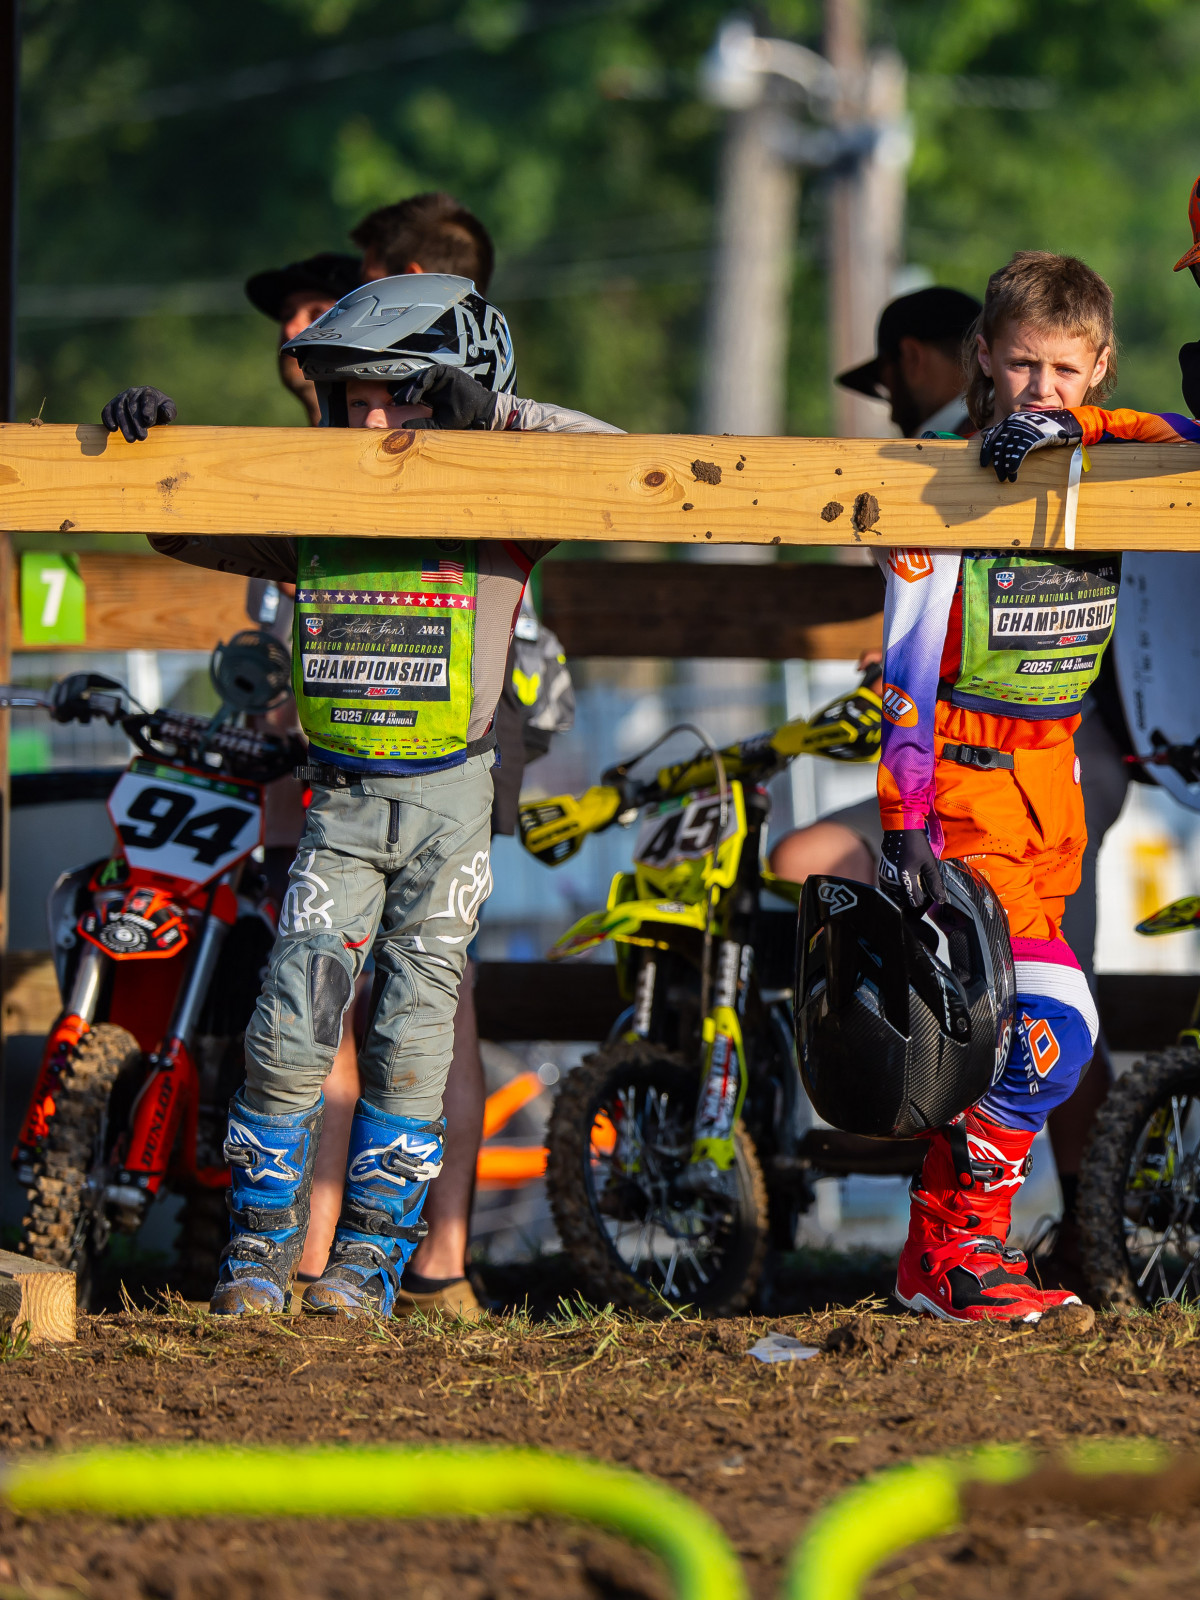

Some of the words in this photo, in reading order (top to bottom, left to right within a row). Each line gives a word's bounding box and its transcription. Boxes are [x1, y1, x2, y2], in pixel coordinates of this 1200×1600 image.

[41, 568, 67, 626] 7
[995, 594, 1036, 604] AMATEUR
[1039, 591, 1074, 603] NATIONAL
[1077, 585, 1116, 599] MOTOCROSS
[996, 603, 1115, 632] CHAMPIONSHIP
[416, 625, 445, 636] AMA
[305, 641, 341, 651] AMATEUR
[344, 642, 386, 652] NATIONAL
[390, 643, 444, 654] MOTOCROSS
[1056, 634, 1089, 646] AMSOIL
[306, 658, 443, 682] CHAMPIONSHIP
[1020, 661, 1053, 673] 2025
[1060, 658, 1073, 671] 44
[1072, 661, 1094, 671] ANNUAL
[364, 687, 401, 696] AMSOIL
[883, 687, 914, 717] 110
[334, 710, 363, 722] 2025
[371, 712, 386, 723] 44
[386, 717, 414, 725] ANNUAL
[882, 704, 901, 722] ACING
[116, 787, 255, 866] 94
[640, 799, 733, 862] 45
[141, 1076, 173, 1167] DUNLOP
